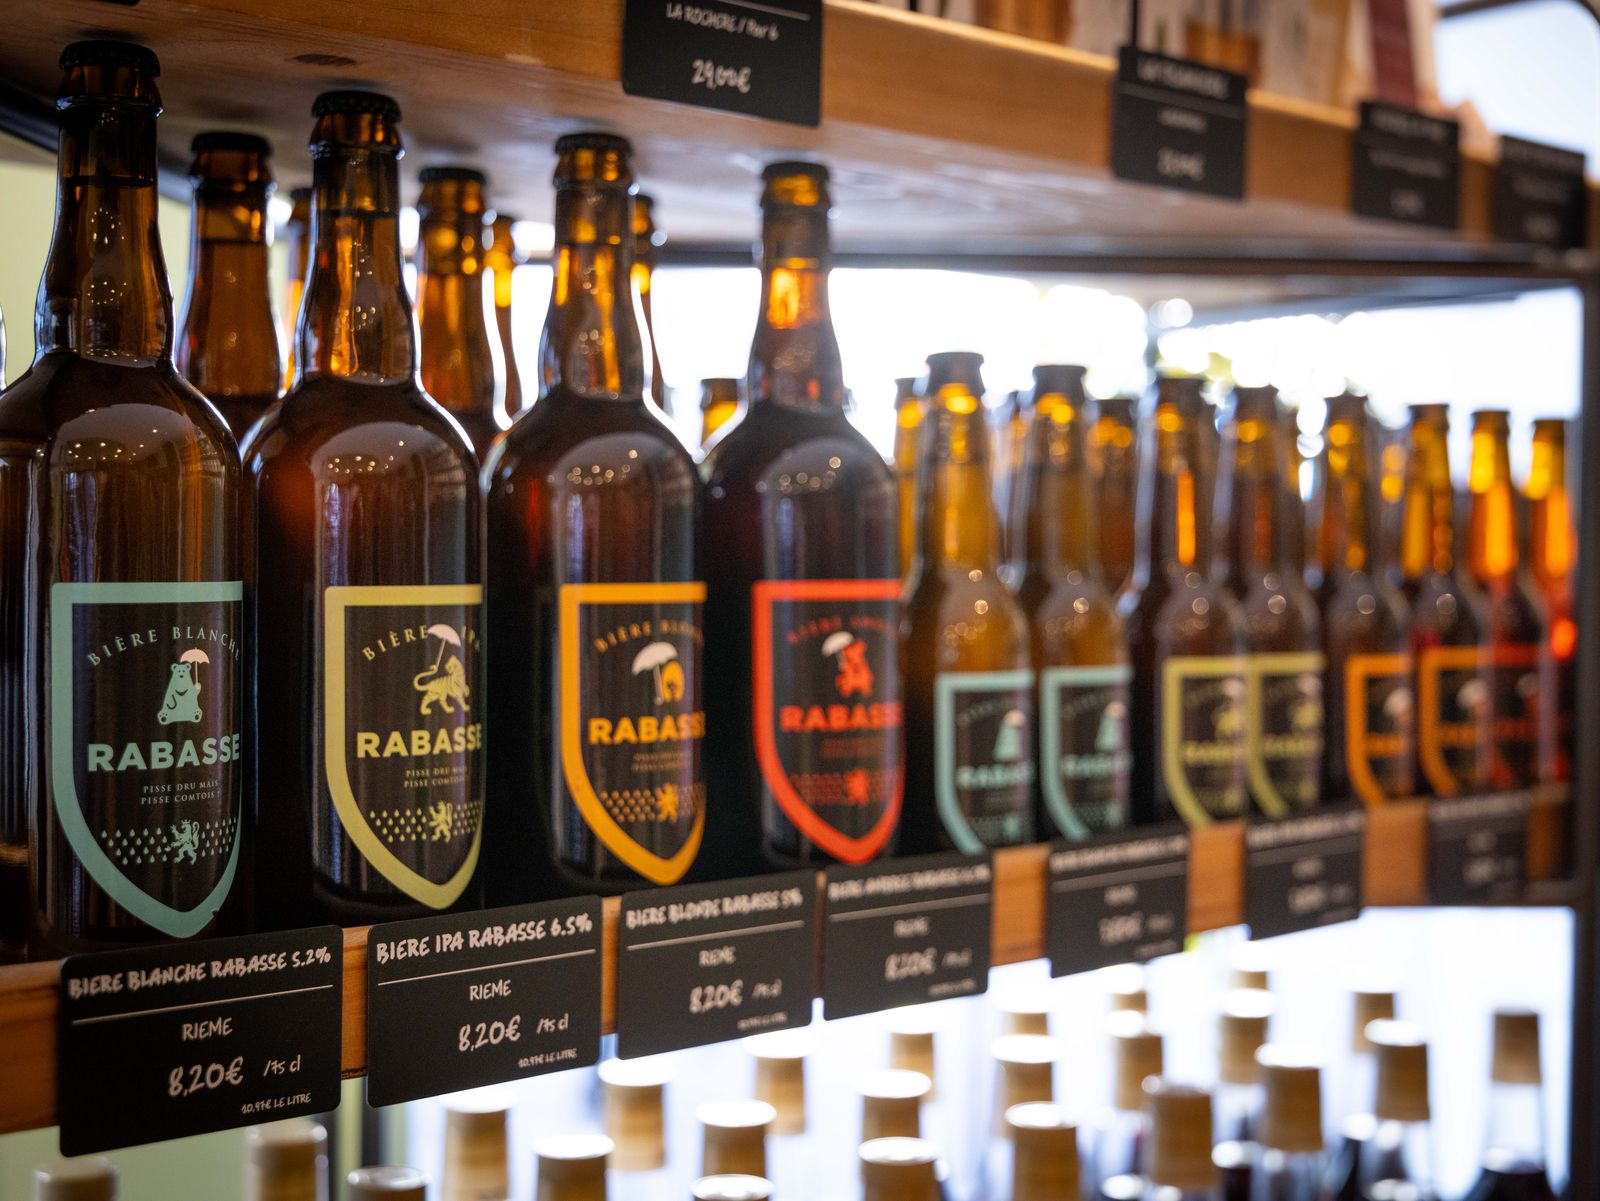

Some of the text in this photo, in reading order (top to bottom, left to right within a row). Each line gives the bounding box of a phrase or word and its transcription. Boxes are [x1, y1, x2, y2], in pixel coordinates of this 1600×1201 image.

[87, 629, 158, 667] BIÈRE
[362, 625, 429, 661] BIÈRE
[87, 733, 240, 772] RABASSE
[357, 722, 482, 758] RABASSE
[141, 796, 170, 805] PISSE
[143, 784, 172, 794] PISSE
[176, 782, 196, 791] DRU
[625, 905, 667, 930] BIERE
[376, 912, 593, 964] BIERE IPA RABASSE 6.5%
[68, 946, 332, 1000] BIERE BLANCHE RABASSE 5.2%
[469, 979, 512, 1001] RIEME
[182, 1017, 233, 1041] RIEME
[458, 1014, 521, 1052] 8,20€
[168, 1056, 244, 1097] 8,20€
[274, 1096, 286, 1108] LE
[287, 1092, 312, 1106] LITRE
